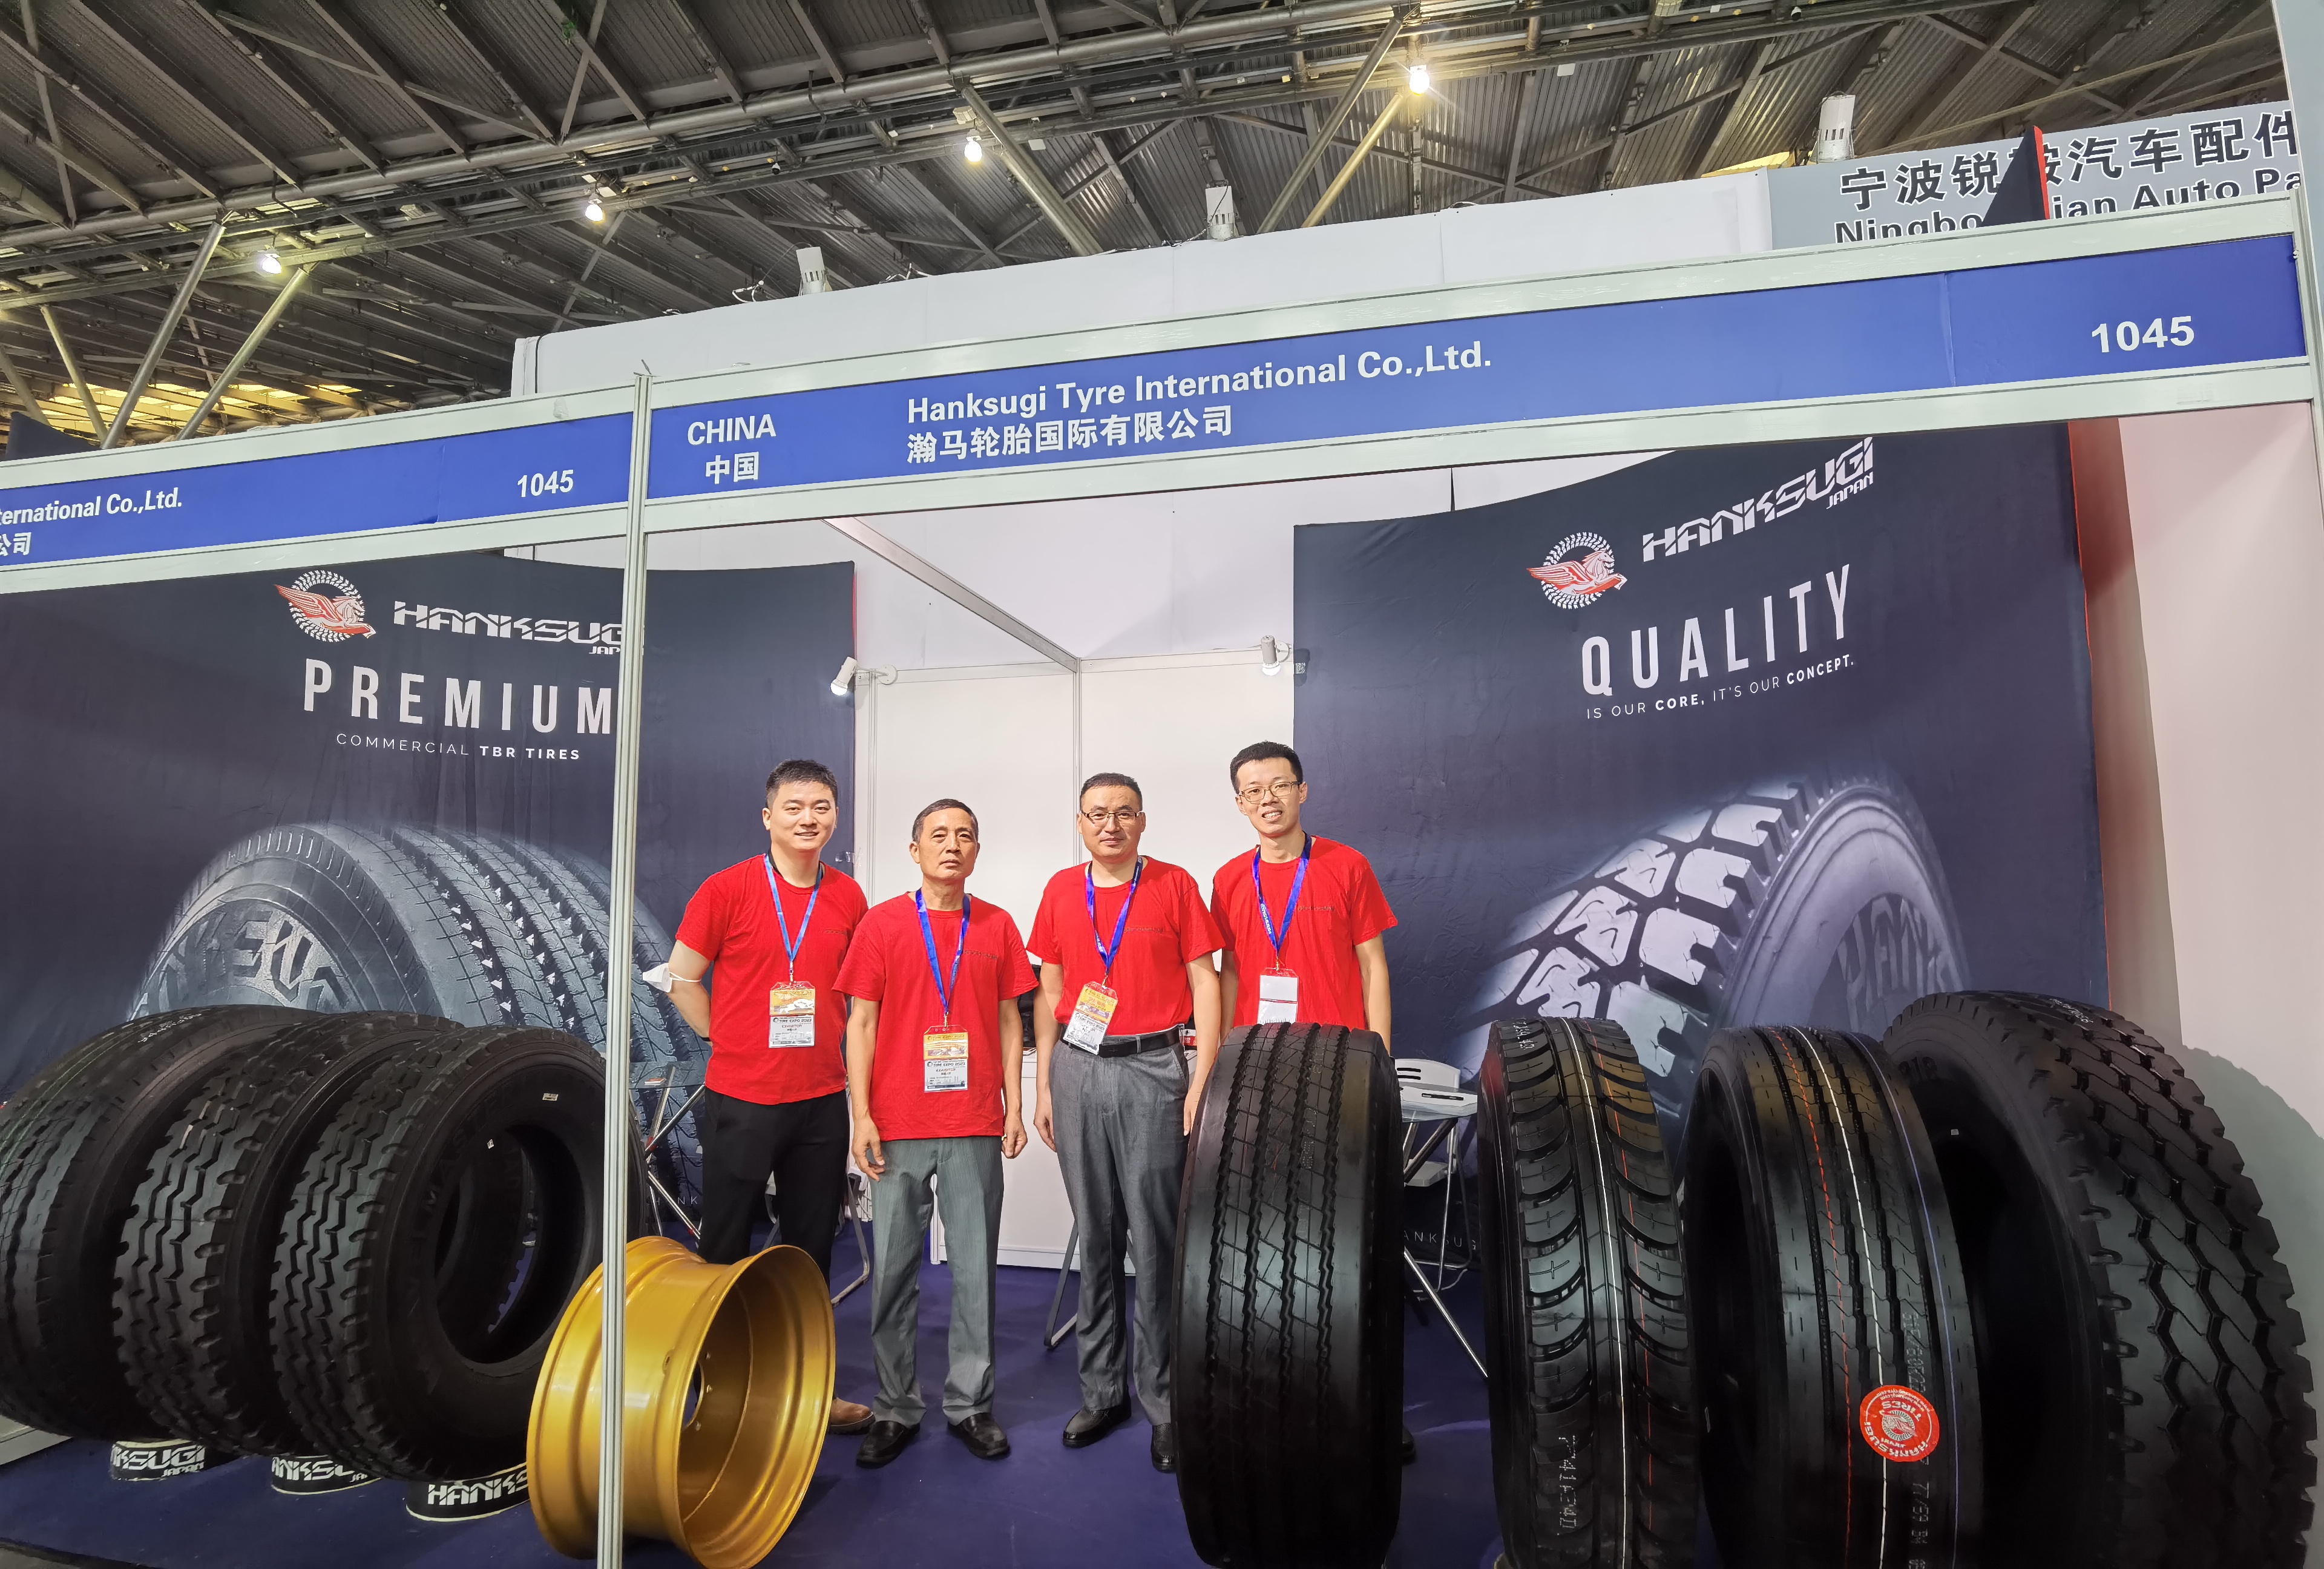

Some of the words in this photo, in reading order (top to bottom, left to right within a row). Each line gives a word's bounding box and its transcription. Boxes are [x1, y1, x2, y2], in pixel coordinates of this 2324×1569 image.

[1835, 210, 1984, 243] Ningbo
[2052, 195, 2118, 219] ian
[2132, 178, 2241, 209] Auto
[2092, 315, 2194, 353] 1045
[908, 386, 1046, 423] Hanksugi
[1057, 382, 1125, 413] Tyre
[1134, 355, 1346, 400] International
[1357, 341, 1491, 378] Co.,Ltd.
[688, 413, 776, 446] CHINA
[907, 405, 1232, 464] 瀚马轮胎国际有限公司
[517, 469, 574, 498] 1045
[705, 451, 760, 485] 中国
[107, 487, 182, 515] Co.,Ltd.
[1643, 436, 1874, 562] HANKSUGI
[1826, 471, 1874, 510] JAPAN
[394, 601, 644, 645] HANKSUG
[1581, 564, 1850, 697] QUALITY
[304, 658, 612, 735] PREMIUM
[1587, 708, 1601, 719] IS
[1611, 702, 1646, 717] OUR
[1655, 694, 1704, 711] CORE,
[1713, 685, 1742, 702] IT'S
[1750, 676, 1779, 694] OUR
[1787, 654, 1854, 685] CONCEPT.
[336, 733, 469, 755] COMMERCIAL
[479, 745, 516, 758] TBR
[525, 748, 580, 760] TIRES
[1882, 1400, 1922, 1422] TIRES
